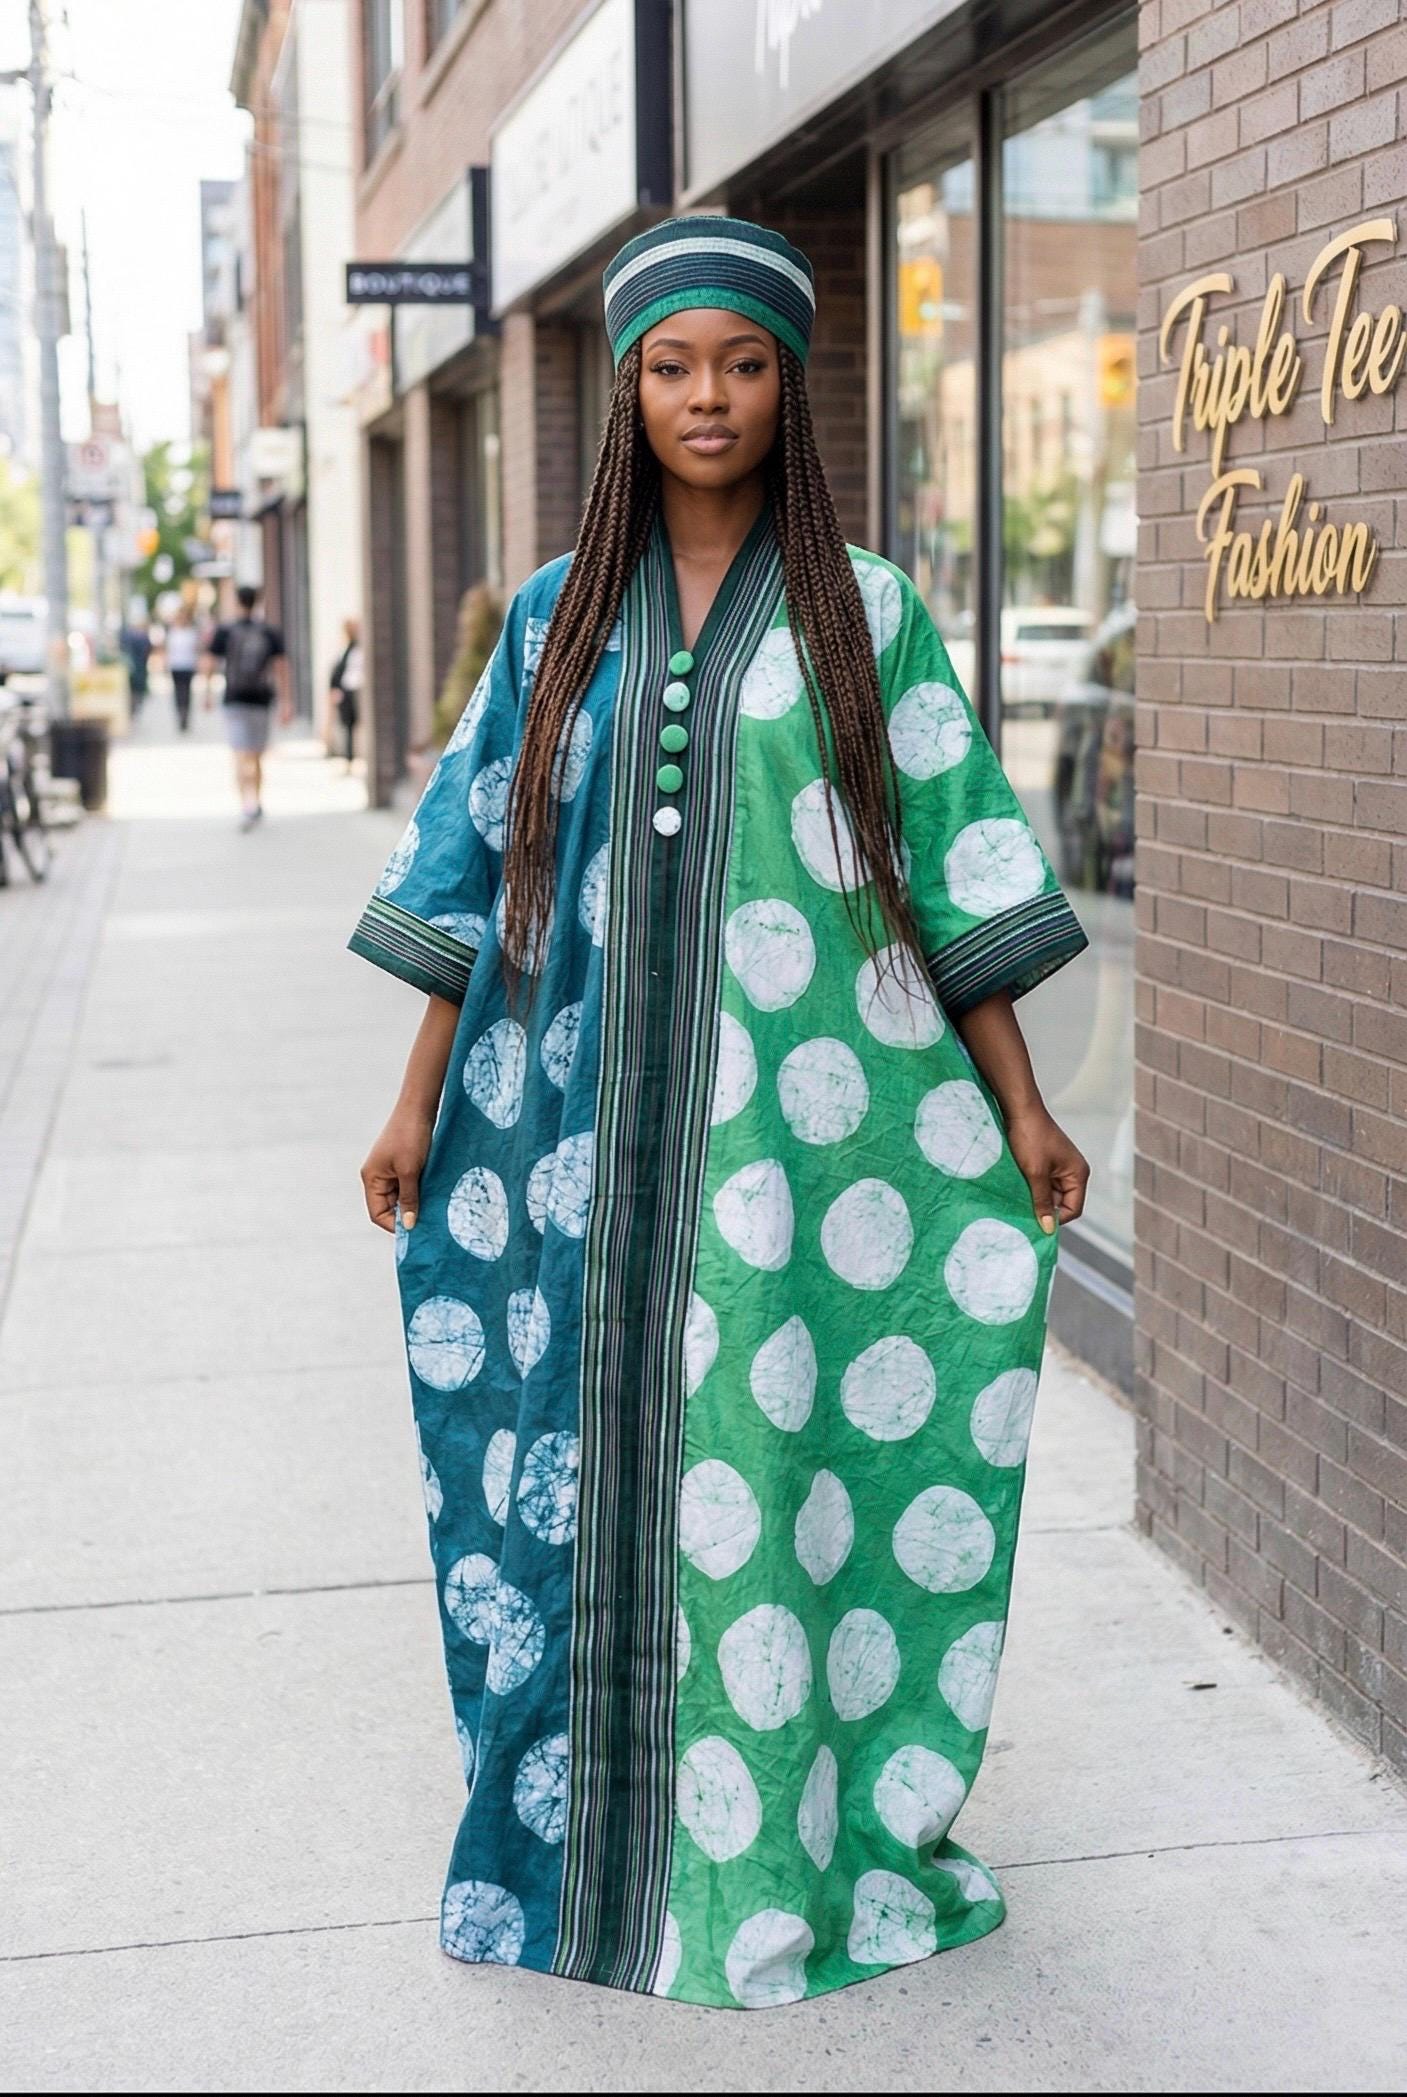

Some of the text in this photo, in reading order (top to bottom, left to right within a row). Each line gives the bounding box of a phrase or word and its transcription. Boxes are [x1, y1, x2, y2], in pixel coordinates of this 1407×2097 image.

[350, 271, 470, 296] BOUTIQUE
[1160, 218, 1407, 478] Triple Tee
[1197, 469, 1377, 623] Fashion
